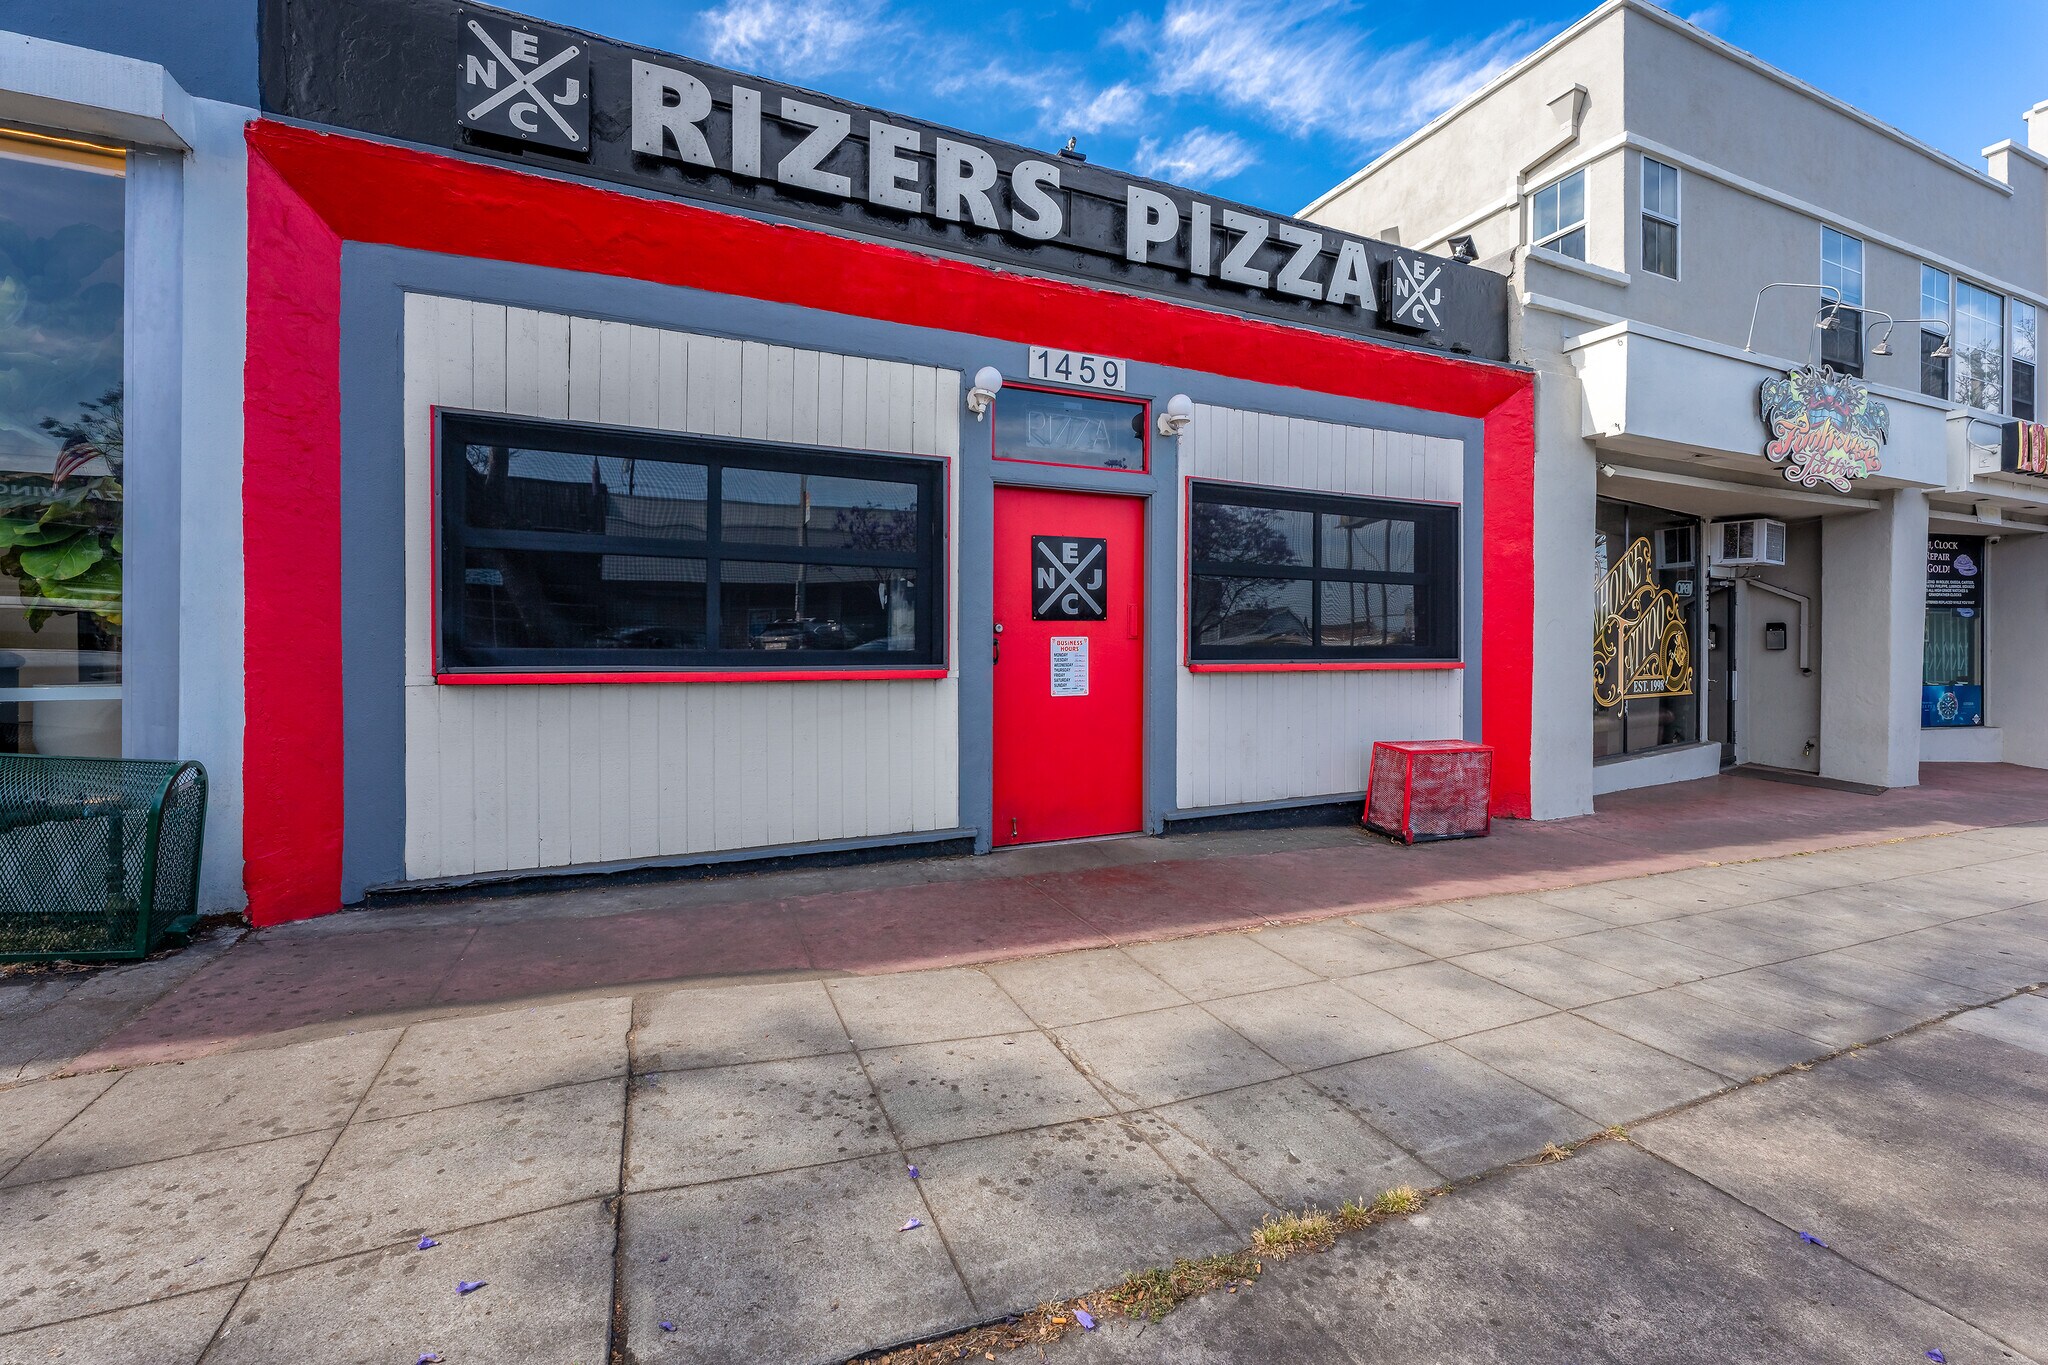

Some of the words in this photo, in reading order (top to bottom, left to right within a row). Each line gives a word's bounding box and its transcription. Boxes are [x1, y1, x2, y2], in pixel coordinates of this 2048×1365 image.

[631, 58, 1062, 240] RIZERS
[1126, 185, 1378, 312] PIZZA
[1038, 350, 1118, 387] 1459
[1028, 411, 1111, 450] PIZZA
[1650, 679, 1665, 691] 1998
